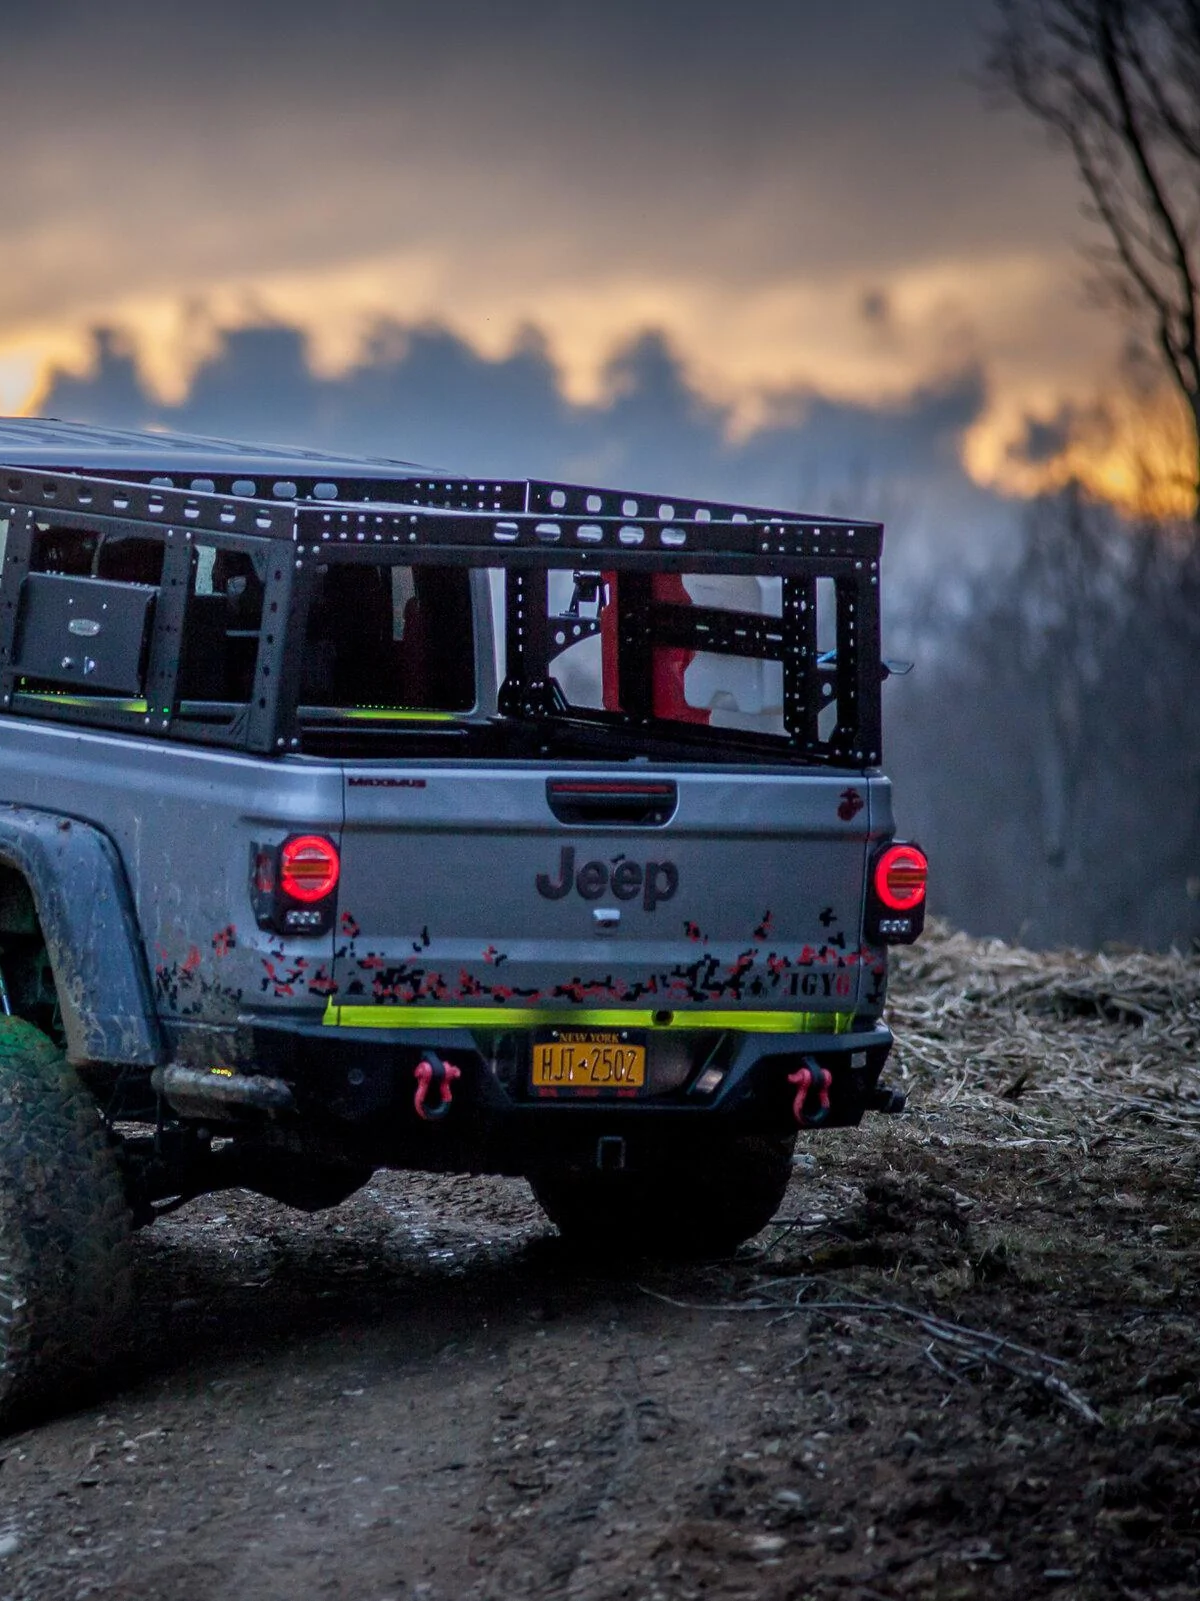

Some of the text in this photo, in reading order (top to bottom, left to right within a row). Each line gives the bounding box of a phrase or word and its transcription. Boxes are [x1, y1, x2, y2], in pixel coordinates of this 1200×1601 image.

[536, 846, 679, 911] Jeep
[559, 1032, 619, 1044] NEW YORK
[542, 1048, 637, 1082] HJT 2502
